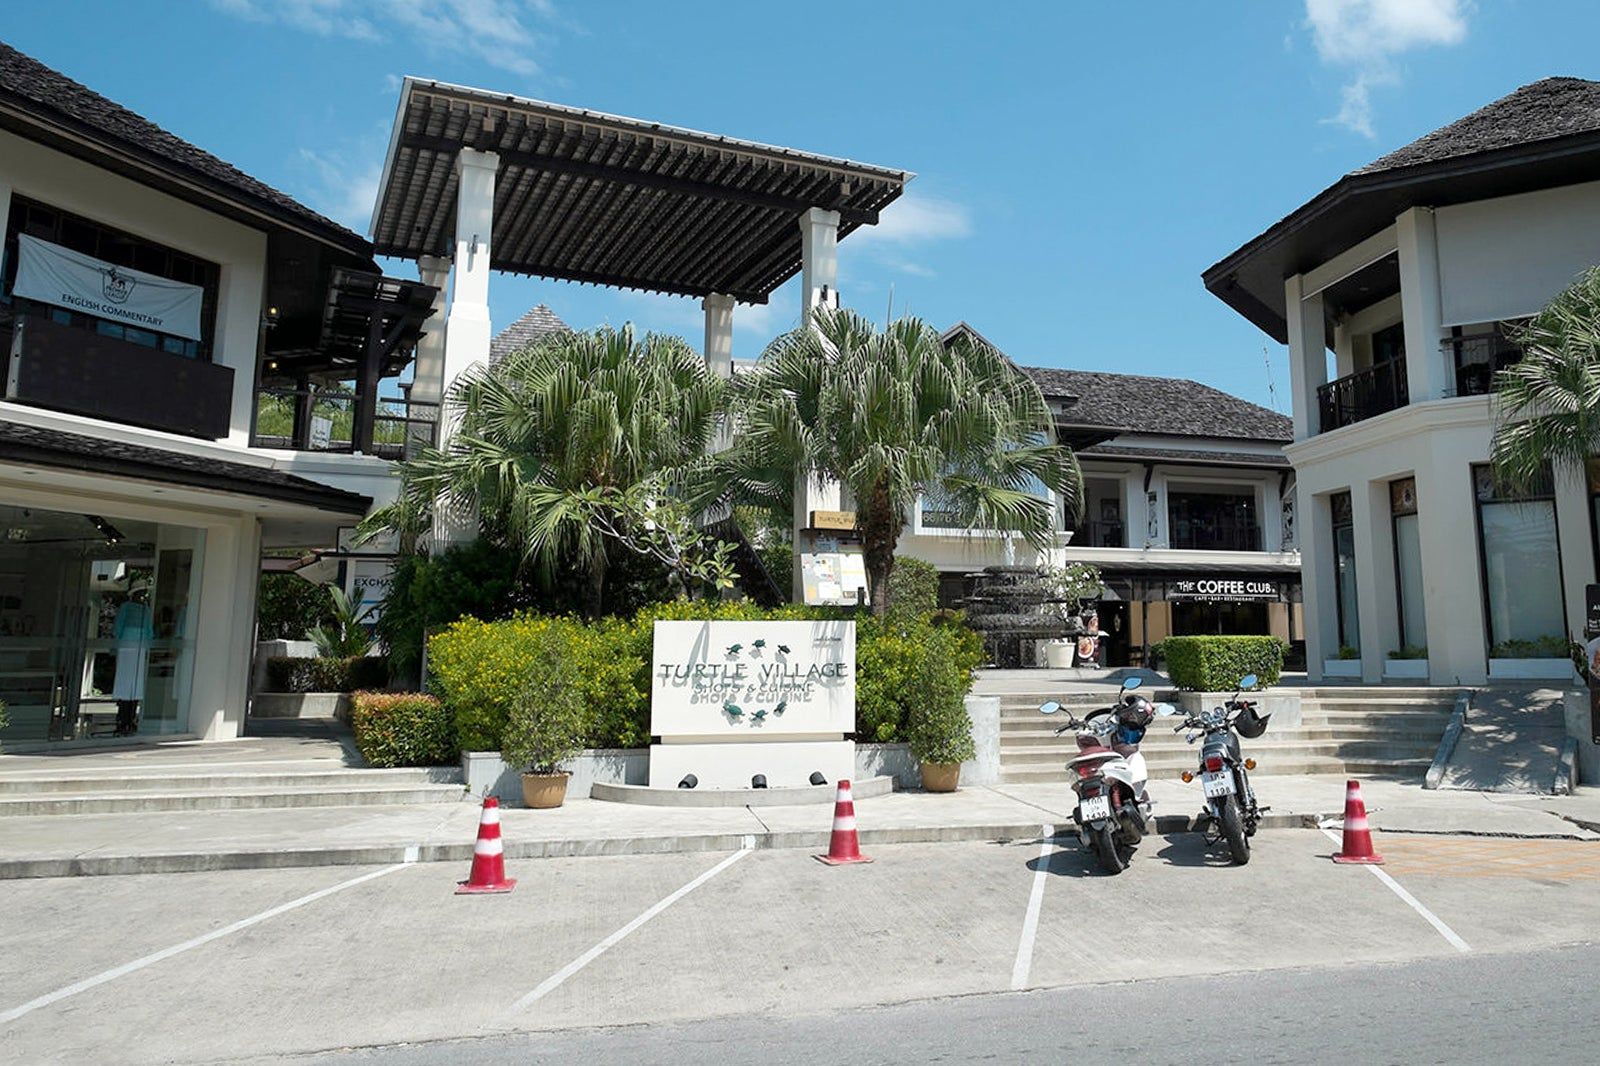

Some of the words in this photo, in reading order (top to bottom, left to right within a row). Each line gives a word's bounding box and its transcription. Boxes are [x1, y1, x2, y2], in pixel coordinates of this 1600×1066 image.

[61, 293, 100, 311] ENGLISH
[101, 304, 164, 326] COMMENTARY
[1177, 581, 1195, 592] THE
[1197, 580, 1244, 594] COFFEE
[660, 663, 748, 679] TURTLE
[761, 663, 849, 678] VILLAGE
[693, 683, 741, 694] SHOPS
[746, 684, 756, 693] &
[759, 682, 816, 693] CUISINE
